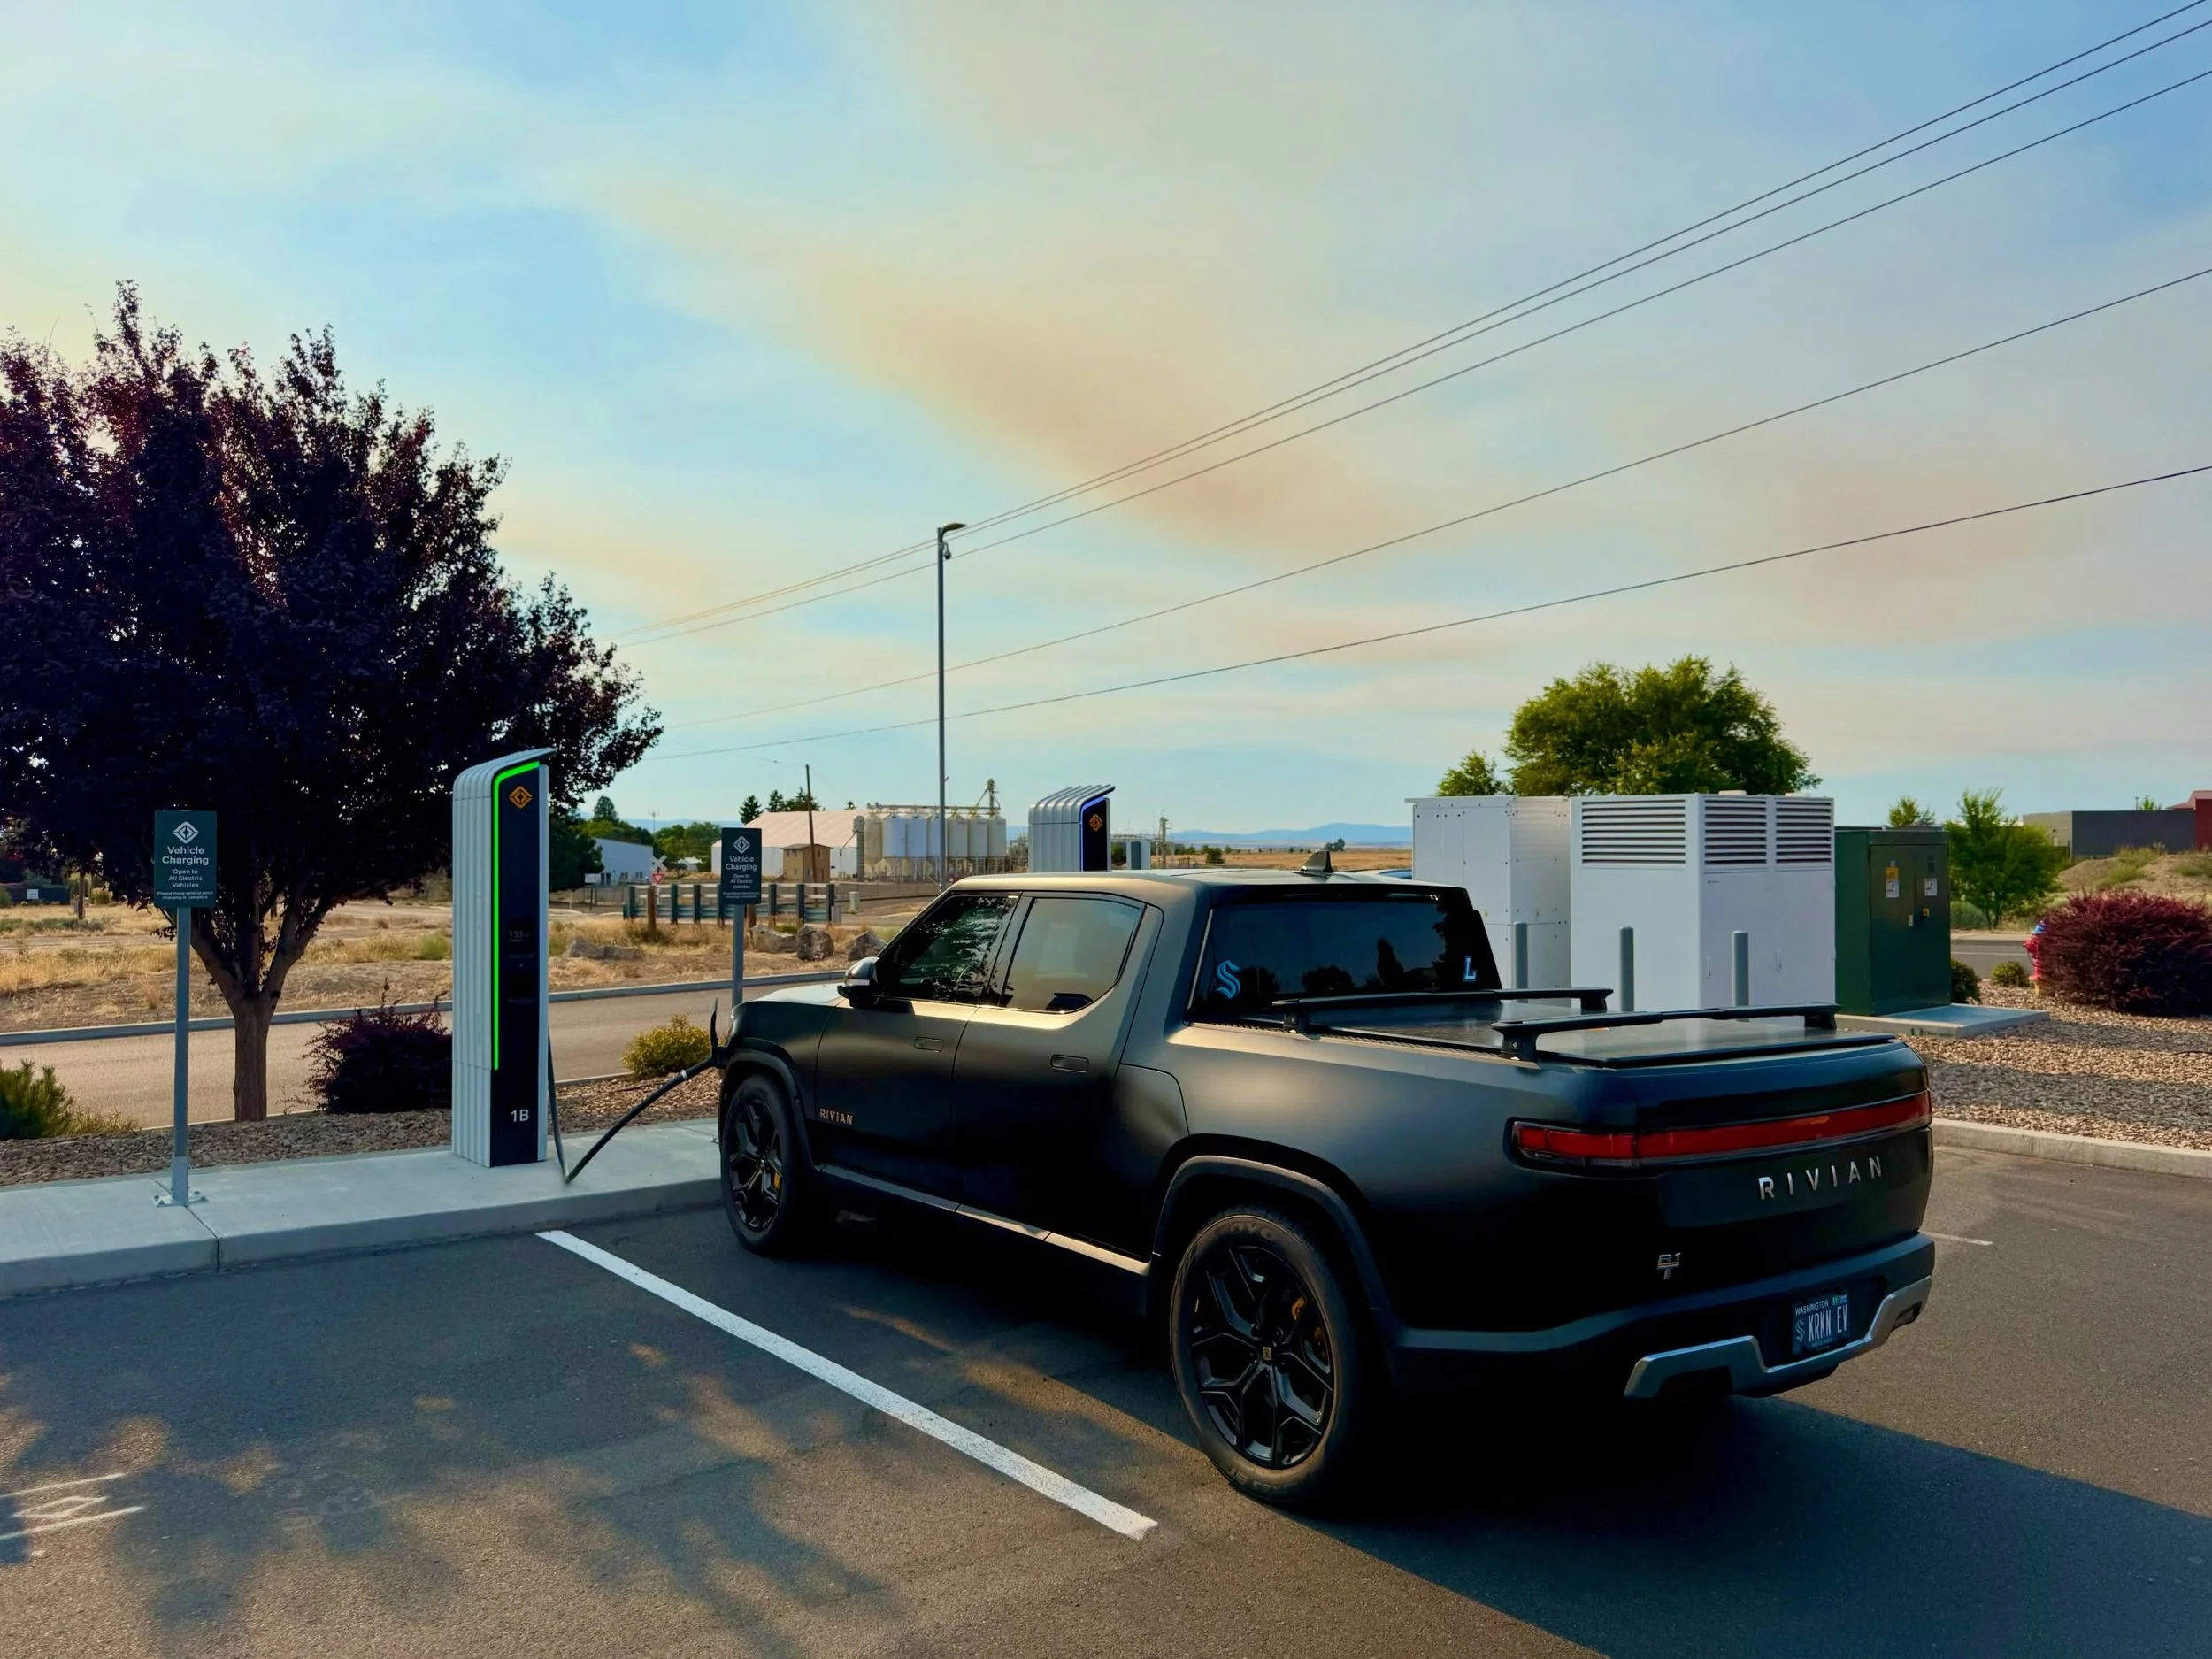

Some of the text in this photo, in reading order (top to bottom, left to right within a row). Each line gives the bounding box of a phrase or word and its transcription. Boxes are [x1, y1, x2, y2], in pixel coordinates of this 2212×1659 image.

[167, 846, 204, 855] Vehicle
[162, 856, 209, 866] Charging
[726, 863, 757, 872] Charging
[511, 1109, 529, 1123] 1B
[819, 1108, 853, 1125] RIVIAN
[1758, 1156, 1882, 1200] RIVIAN
[1795, 1299, 1829, 1316] WASHINGTON
[1809, 1309, 1832, 1342] KRKN
[1837, 1304, 1847, 1333] EV
